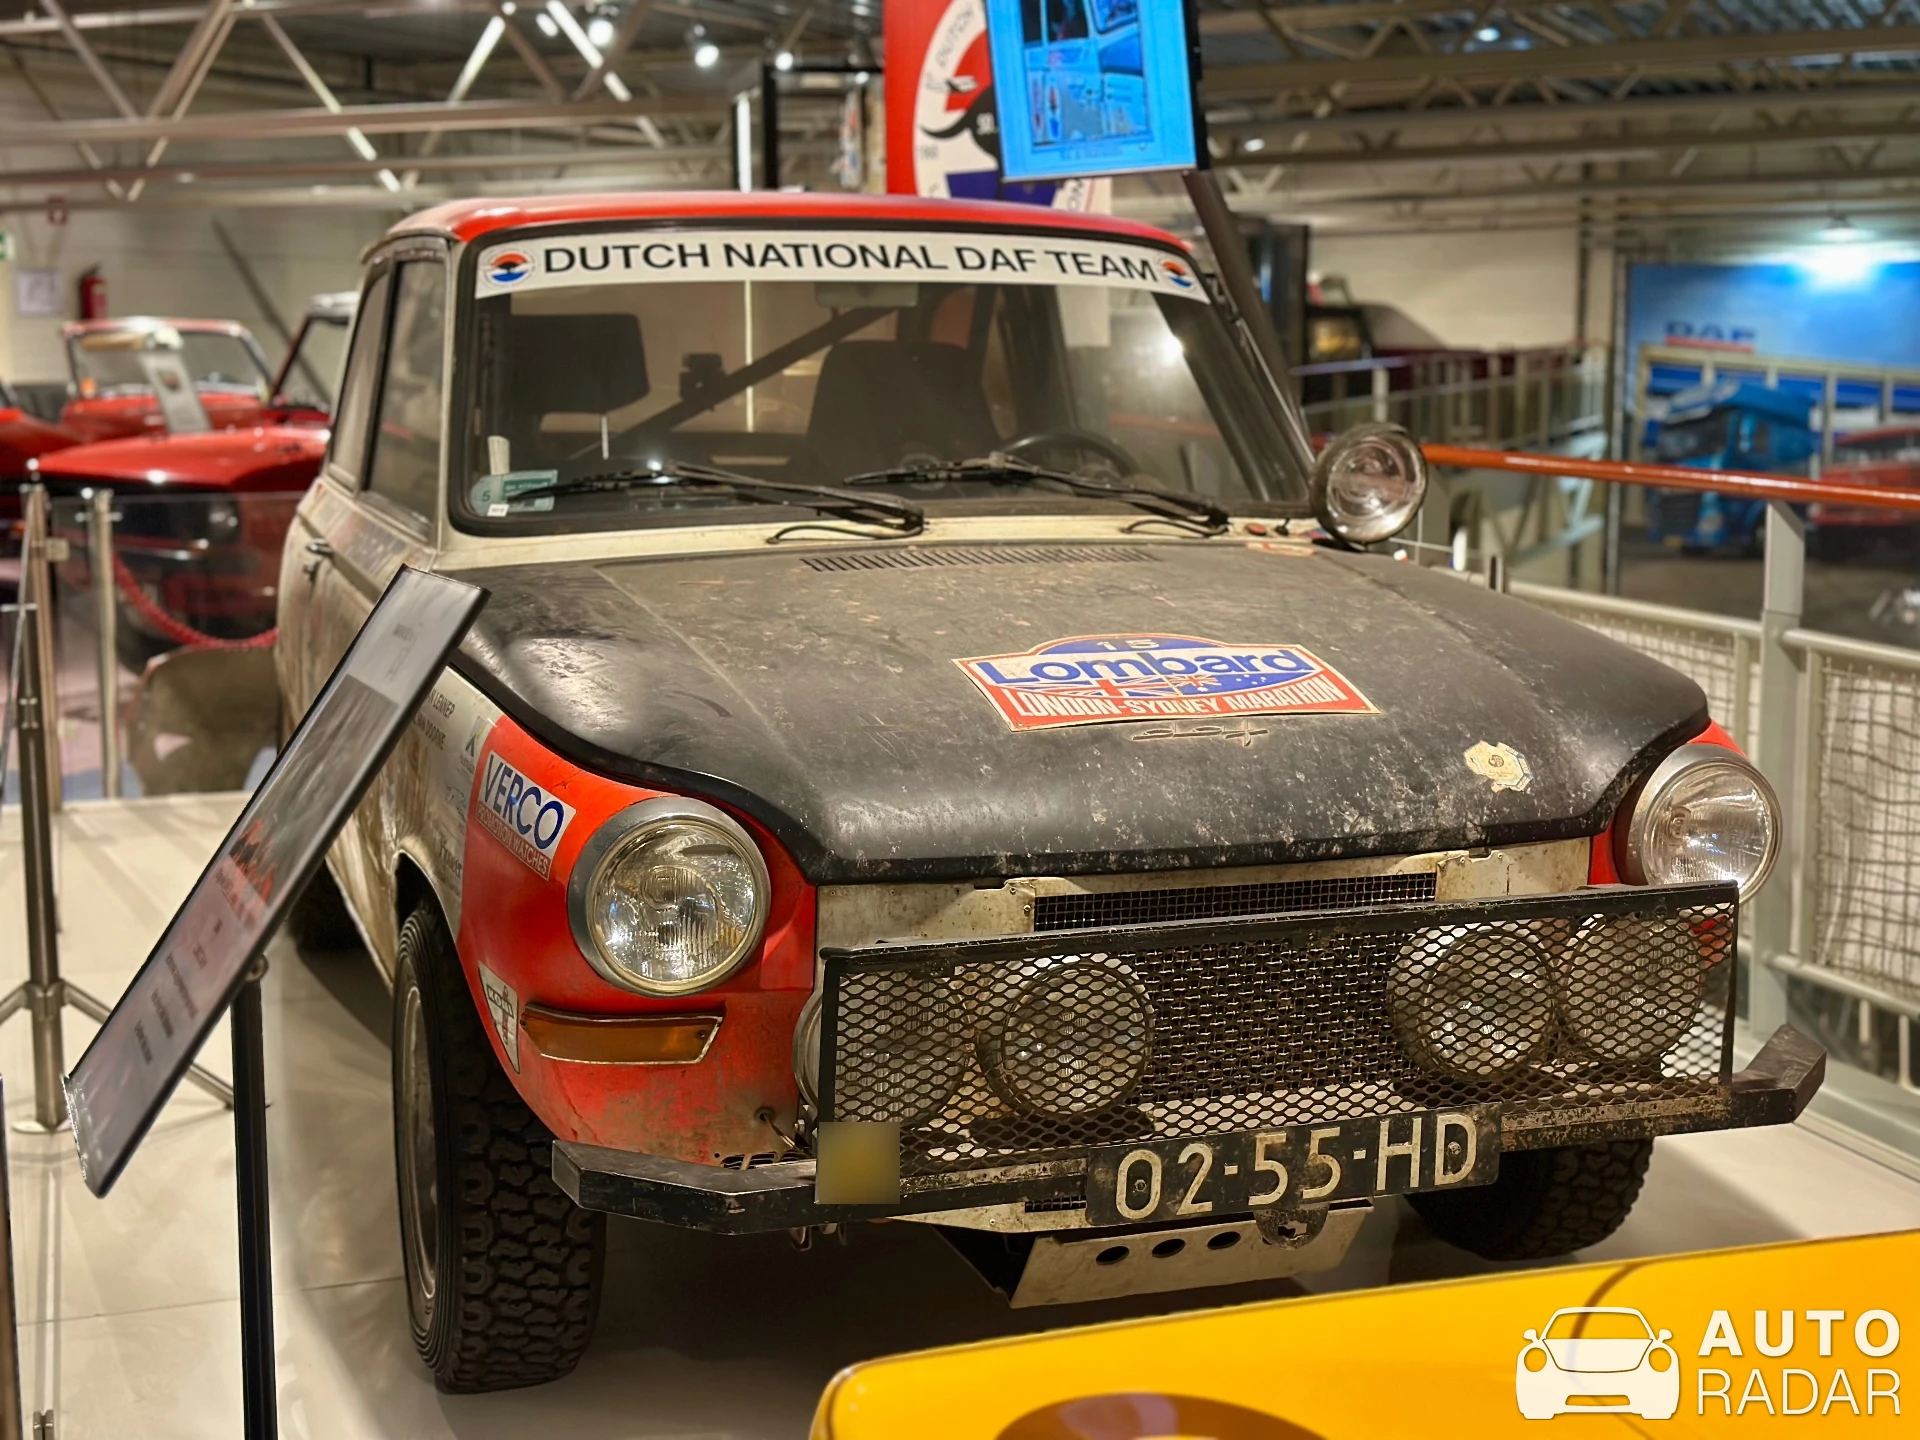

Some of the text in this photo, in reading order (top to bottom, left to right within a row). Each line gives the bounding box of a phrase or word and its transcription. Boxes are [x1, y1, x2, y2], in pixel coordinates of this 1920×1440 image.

[544, 243, 1158, 282] DUTCH NATIONAL DAF TEAM
[1097, 639, 1159, 651] 15
[975, 648, 1316, 685] Lombard
[1001, 673, 1349, 717] LONDON-SYDNEY MARATHON
[484, 753, 565, 850] VERCO
[513, 833, 549, 875] WATCHES
[1114, 1113, 1478, 1220] 02-55-HD
